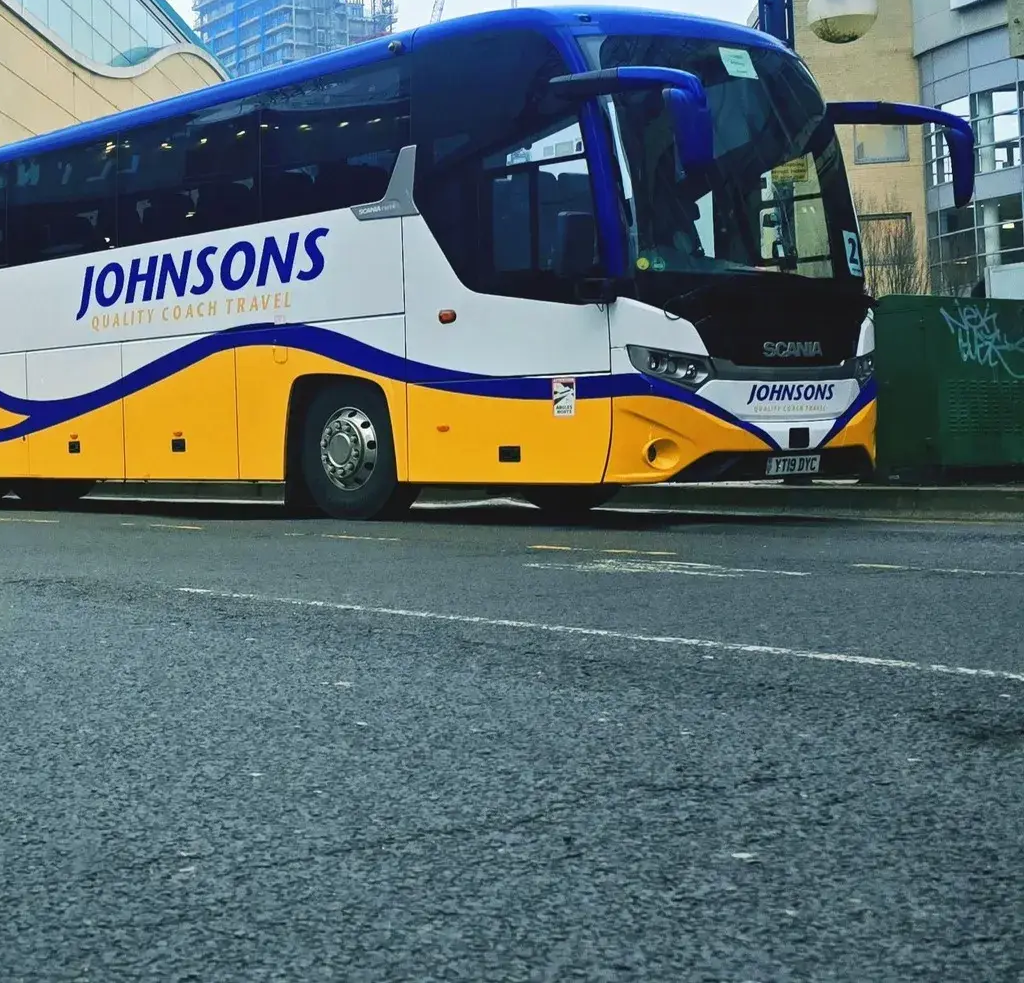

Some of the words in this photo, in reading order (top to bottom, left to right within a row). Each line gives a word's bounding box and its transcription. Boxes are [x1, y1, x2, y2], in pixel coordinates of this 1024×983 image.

[847, 237, 859, 265] 2
[76, 228, 330, 321] JOHNSONS
[91, 309, 155, 332] QUALITY
[162, 301, 218, 322] COACH
[226, 291, 292, 315] TRAVEL
[762, 341, 822, 357] SCANIA
[747, 384, 835, 405] JOHNSONS
[775, 457, 797, 473] YT19
[797, 456, 817, 472] DYC
